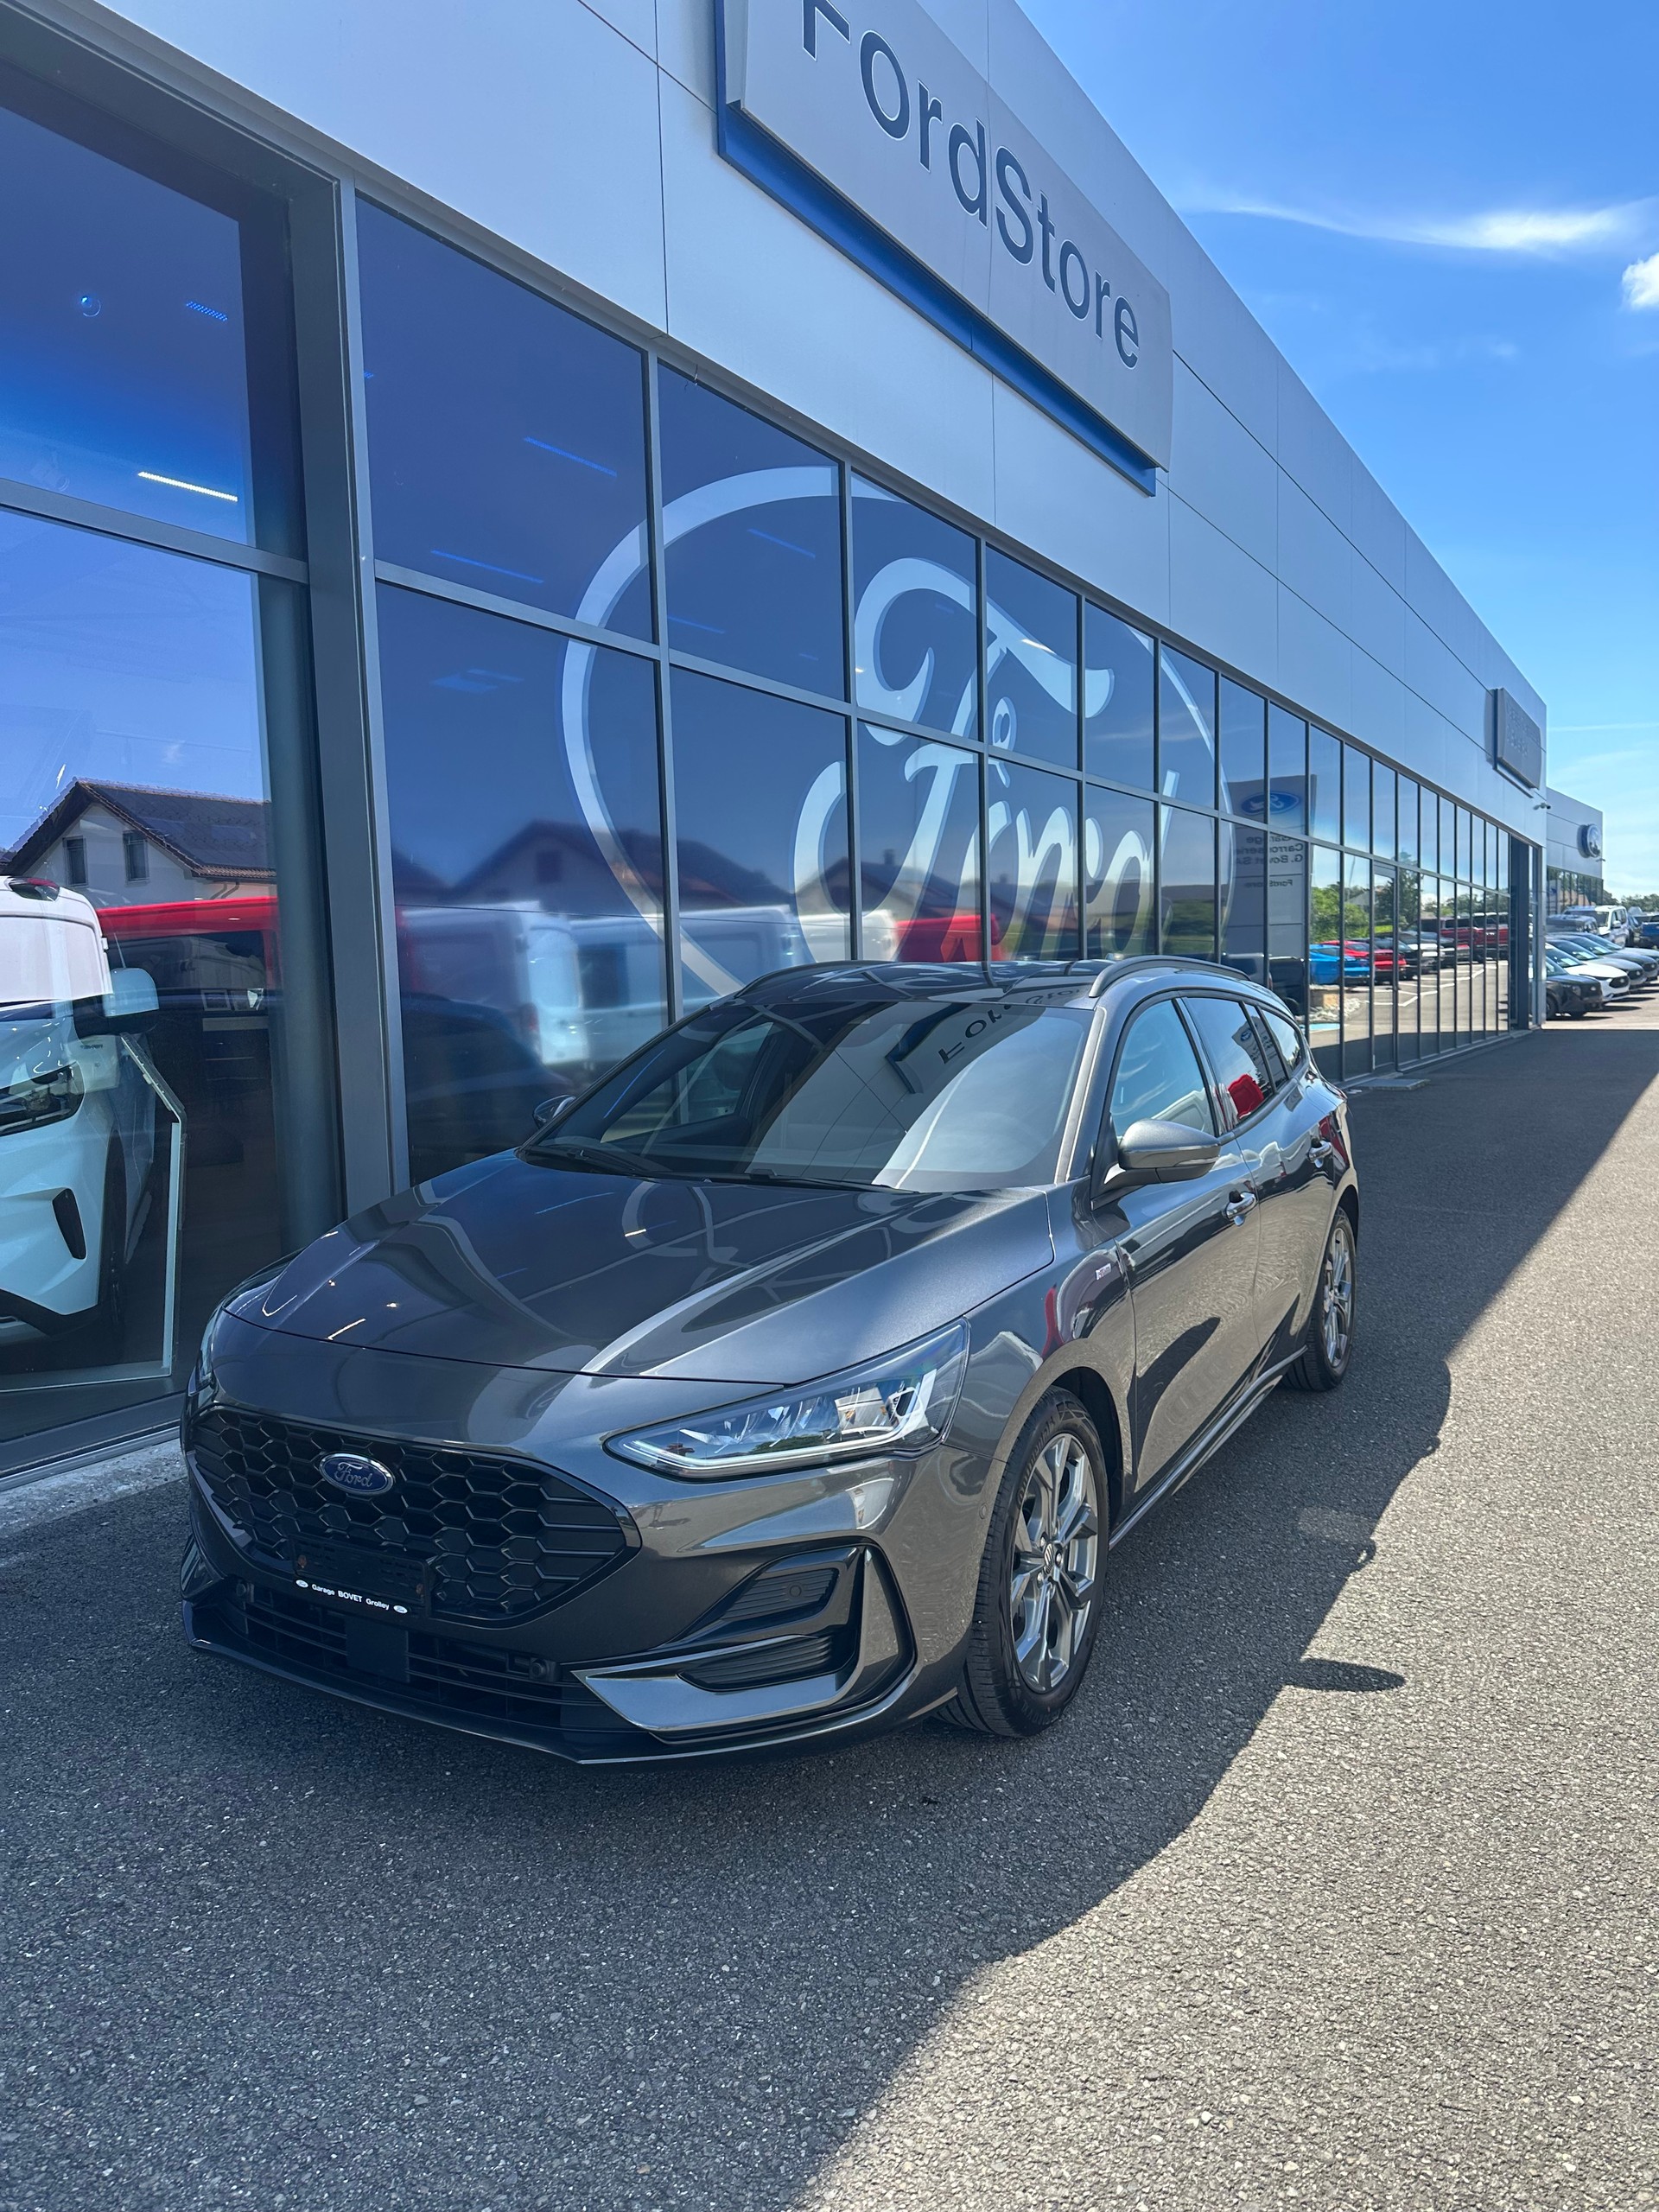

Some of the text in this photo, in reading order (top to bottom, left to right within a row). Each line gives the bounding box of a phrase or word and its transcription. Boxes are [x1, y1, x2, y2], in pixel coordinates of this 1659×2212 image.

[792, 557, 1181, 961] Ford
[334, 1461, 373, 1488] Ford
[312, 1584, 335, 1596] Garage
[338, 1590, 363, 1603] BOVET
[365, 1598, 390, 1611] Grolley
